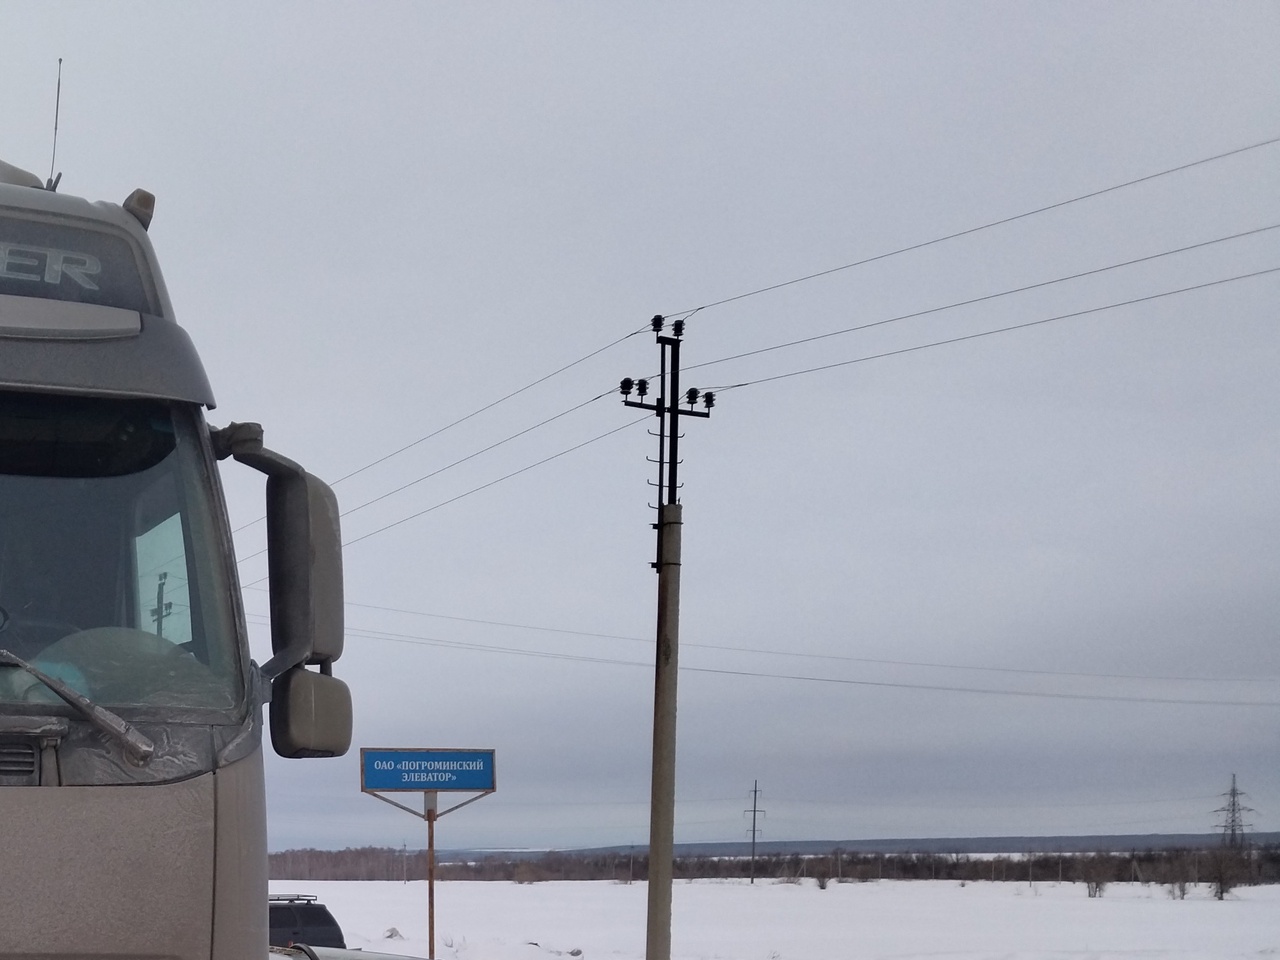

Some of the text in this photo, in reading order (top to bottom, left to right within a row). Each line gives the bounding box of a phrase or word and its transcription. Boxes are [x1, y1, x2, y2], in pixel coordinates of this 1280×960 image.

[374, 758, 484, 771] ОАО «ПОГРОМИНСКИЙ
[401, 772, 457, 782] ЭЛЕВАТОР»
